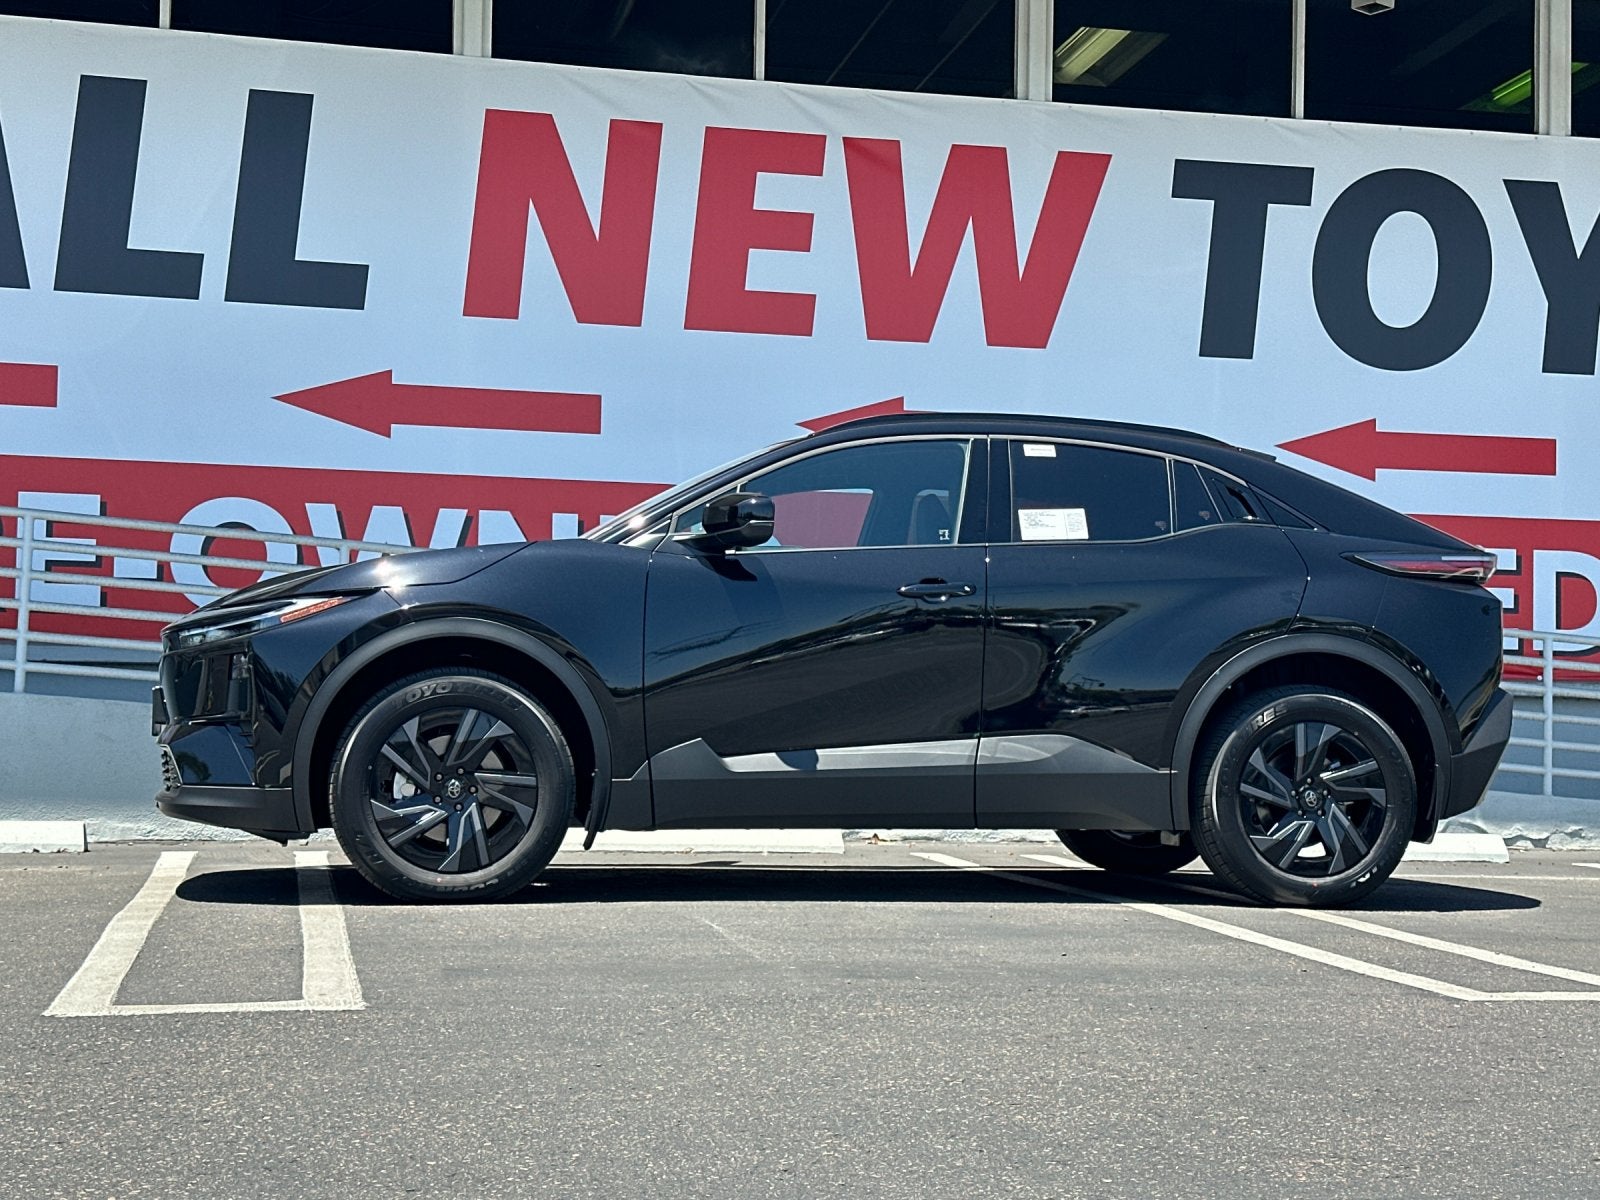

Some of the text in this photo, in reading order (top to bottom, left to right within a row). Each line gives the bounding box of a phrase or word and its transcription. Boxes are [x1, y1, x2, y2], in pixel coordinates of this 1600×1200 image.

[0, 75, 1600, 376] LL NEW TOY
